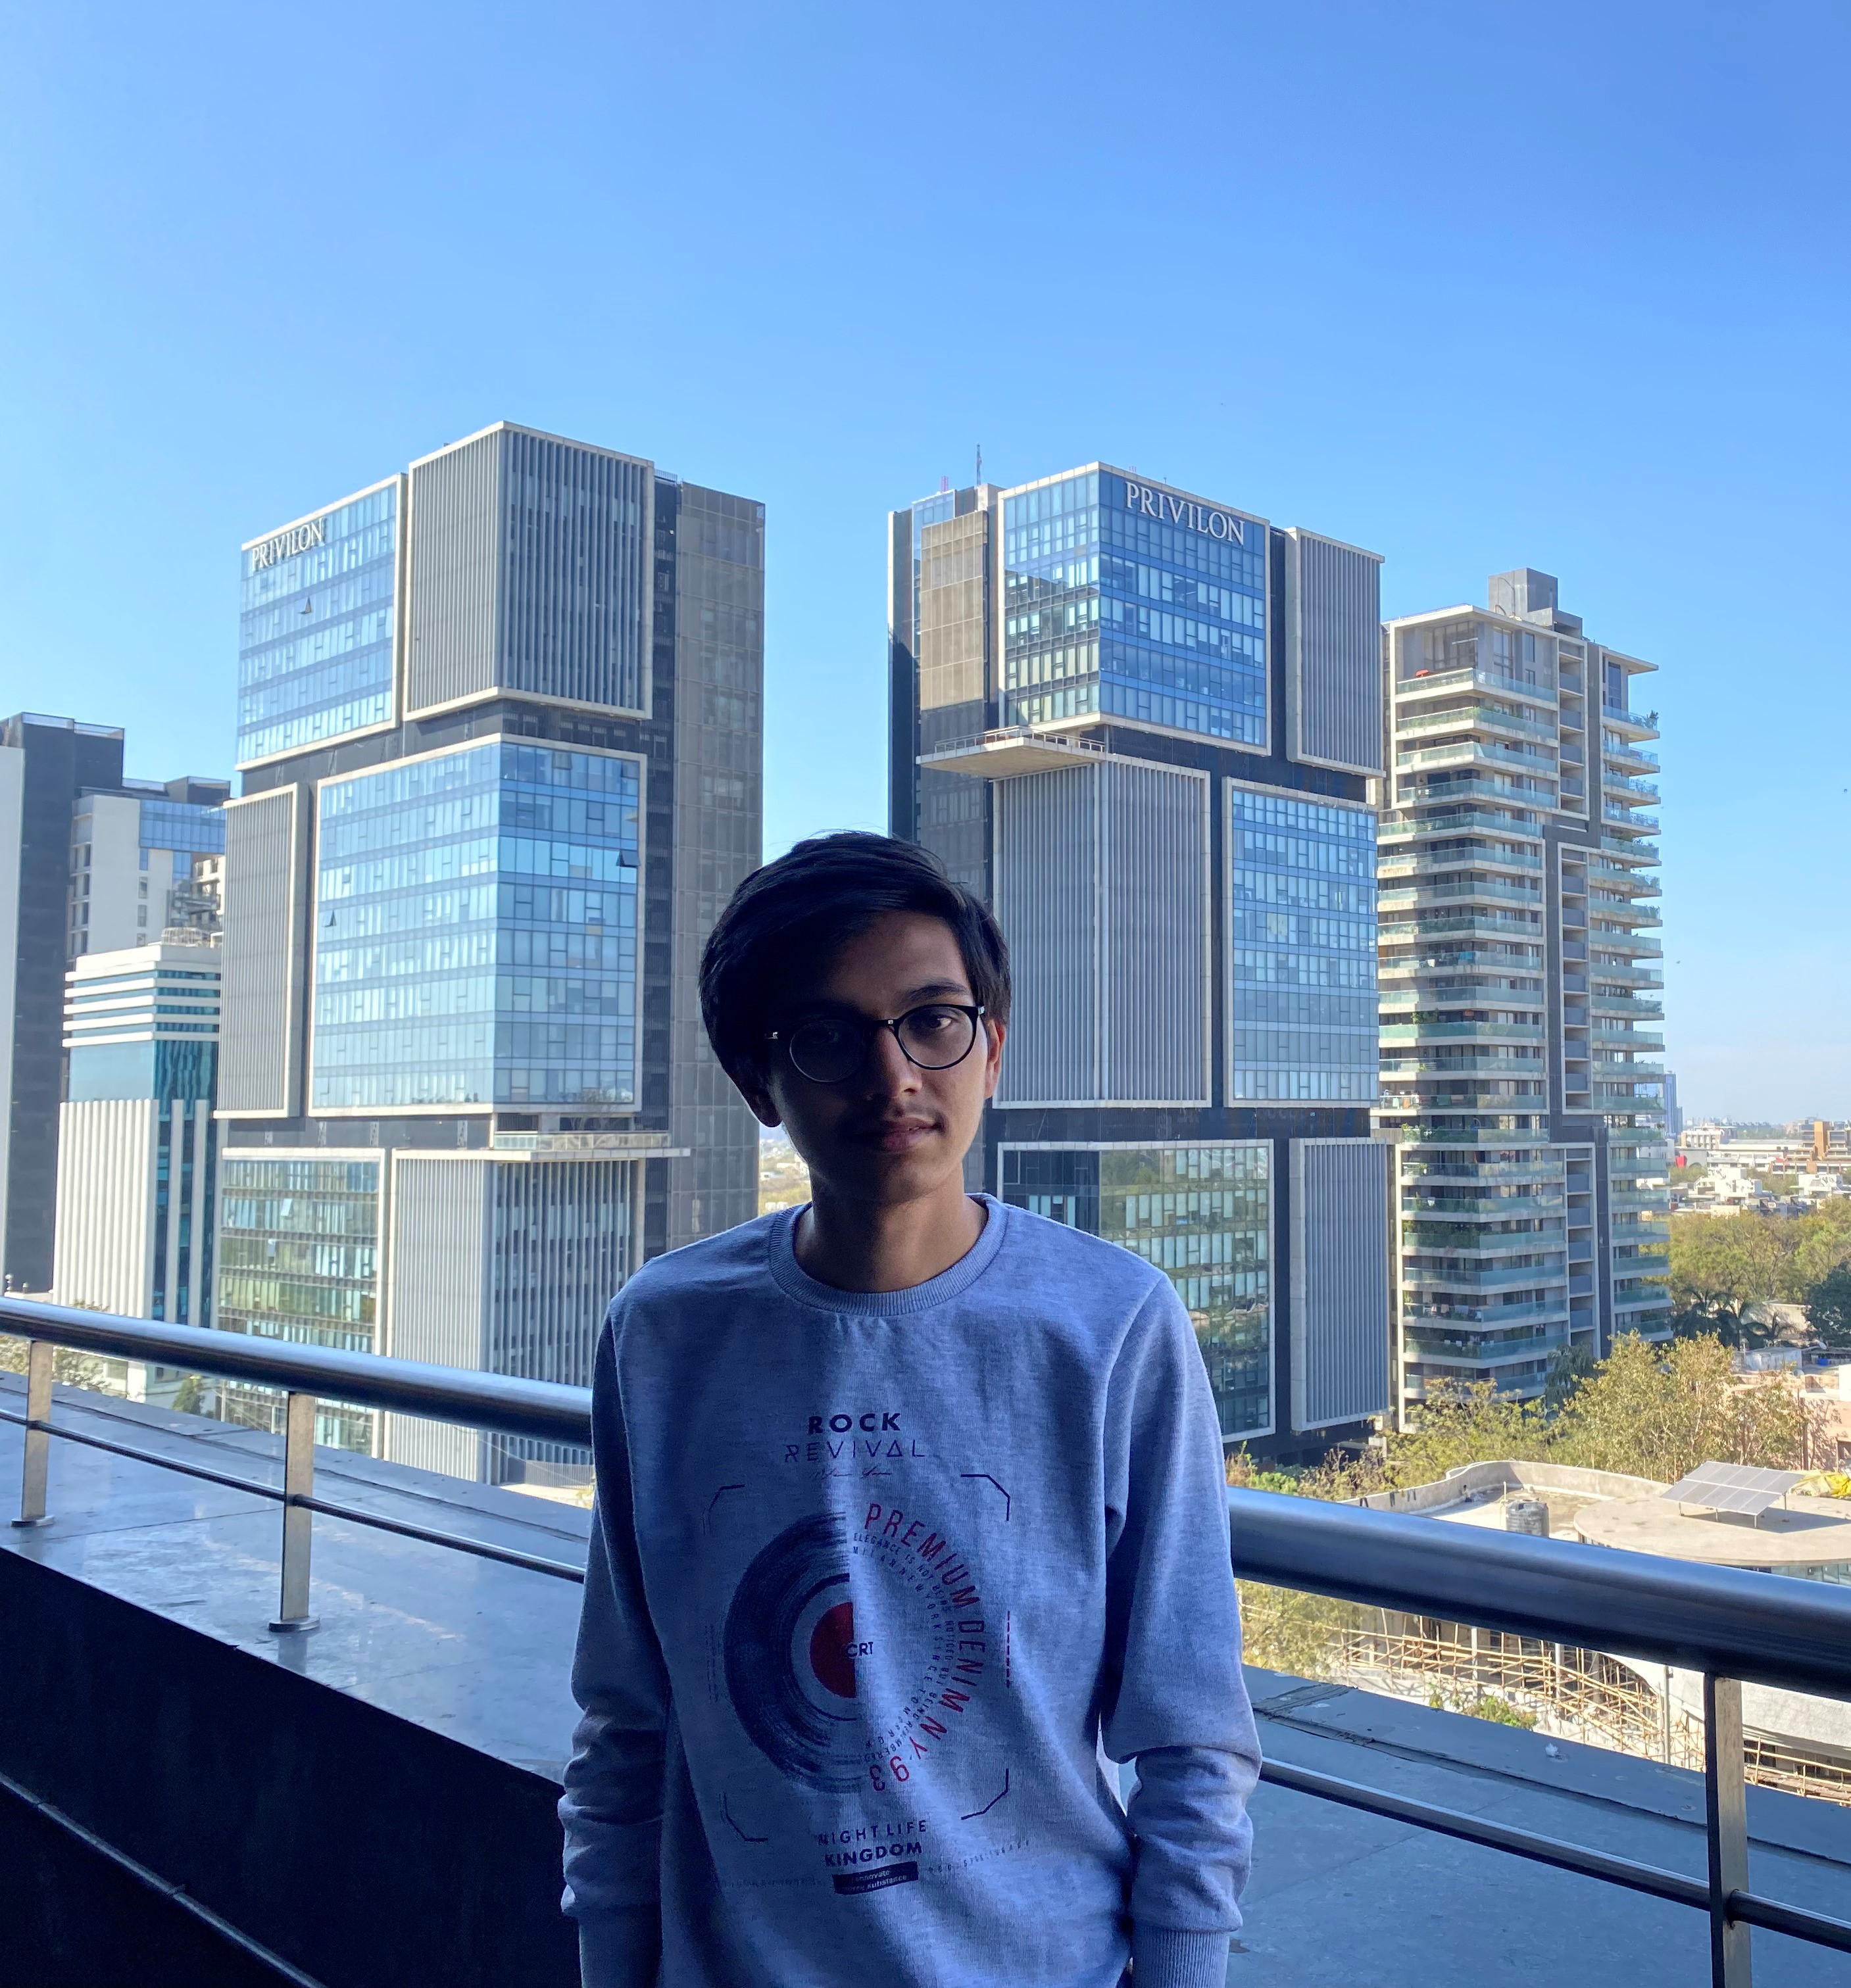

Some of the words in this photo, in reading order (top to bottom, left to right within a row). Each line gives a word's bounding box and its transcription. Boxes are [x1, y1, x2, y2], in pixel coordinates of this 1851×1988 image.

[1125, 481, 1245, 545] PRIVILON
[252, 518, 326, 571] PRIVILON
[808, 1413, 901, 1434] ROCK
[785, 1439, 925, 1463] REVIVAL
[853, 1532, 901, 1555] ELEGANCE
[904, 1553, 915, 1564] IS
[917, 1564, 934, 1580] NOT
[864, 1503, 980, 1609] PREMIUM
[938, 1620, 986, 1712] DENIM
[846, 1641, 874, 1657] CRT
[818, 1825, 879, 1845] NIGHT
[887, 1820, 926, 1837] LIFE
[825, 1841, 922, 1866] KINGDOM
